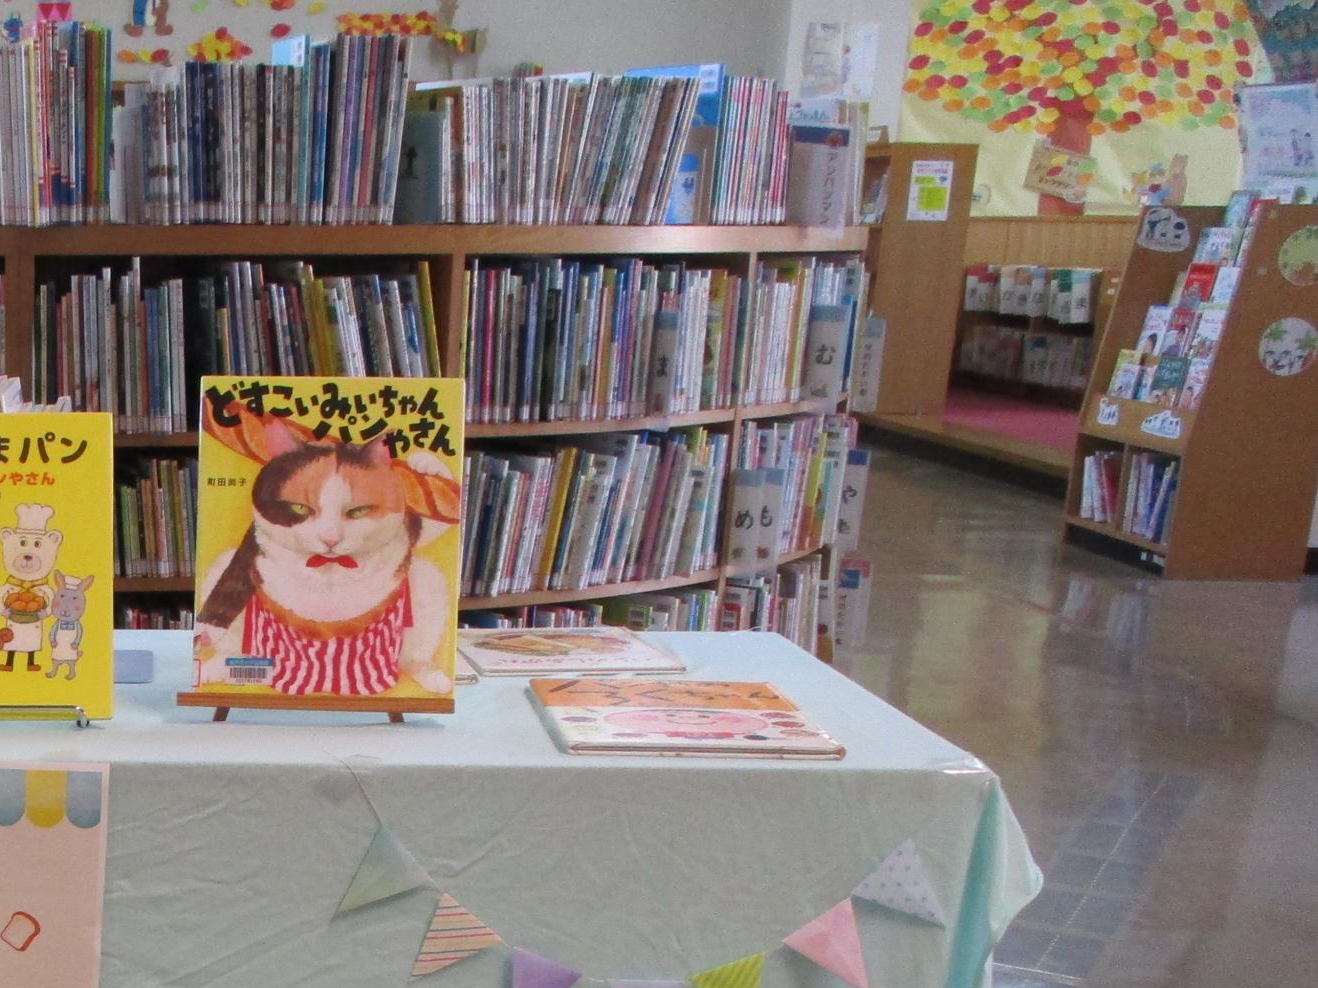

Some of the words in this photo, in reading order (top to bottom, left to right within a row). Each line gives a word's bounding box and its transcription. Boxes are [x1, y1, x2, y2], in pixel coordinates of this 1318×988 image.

[814, 344, 836, 366] む
[204, 380, 445, 428] どすこいみいちゃん
[312, 414, 456, 458] パンやさん
[735, 510, 754, 530] め
[760, 505, 773, 527] も
